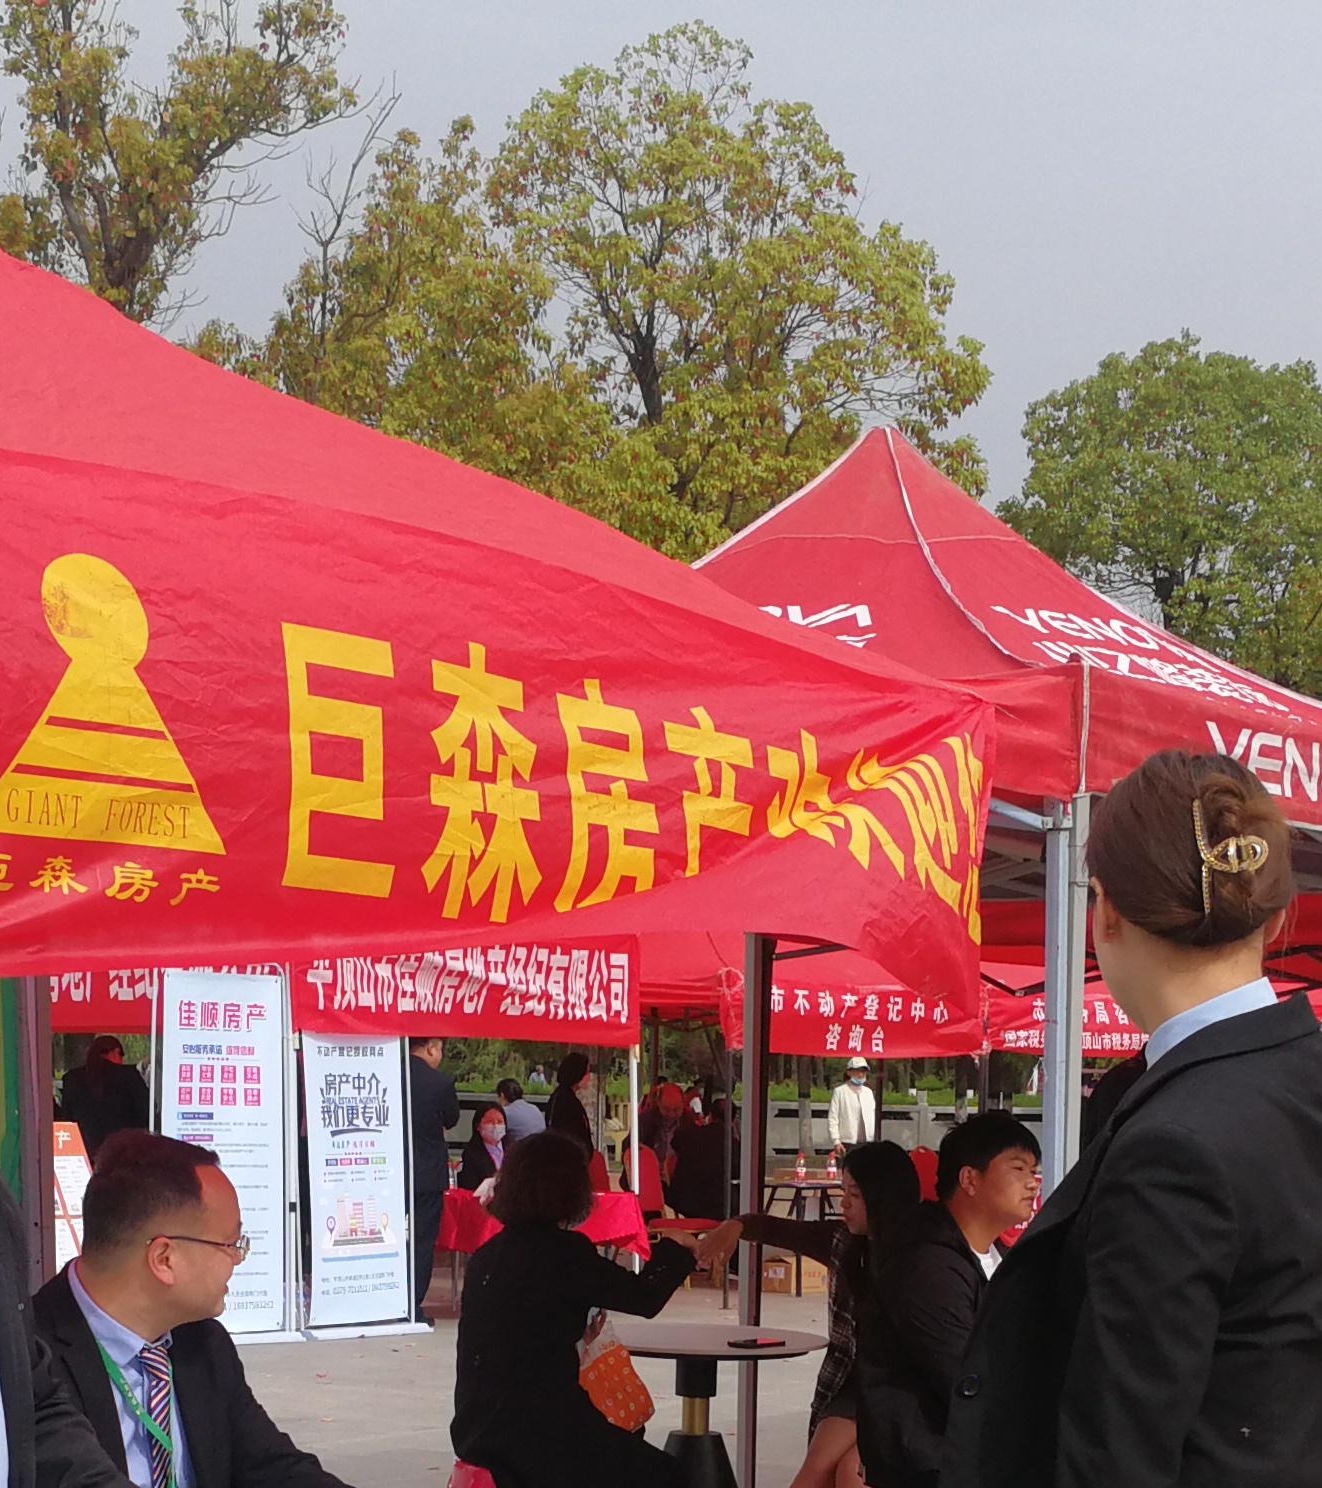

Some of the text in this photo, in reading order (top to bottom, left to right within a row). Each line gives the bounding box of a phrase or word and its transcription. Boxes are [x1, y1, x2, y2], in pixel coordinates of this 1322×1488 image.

[5, 787, 193, 842] GIANT FOREST
[178, 999, 268, 1033] 佳顺房产
[825, 1023, 886, 1054] 咨询台
[324, 1071, 382, 1096] 房产中介
[320, 1103, 391, 1129] 我们更专业
